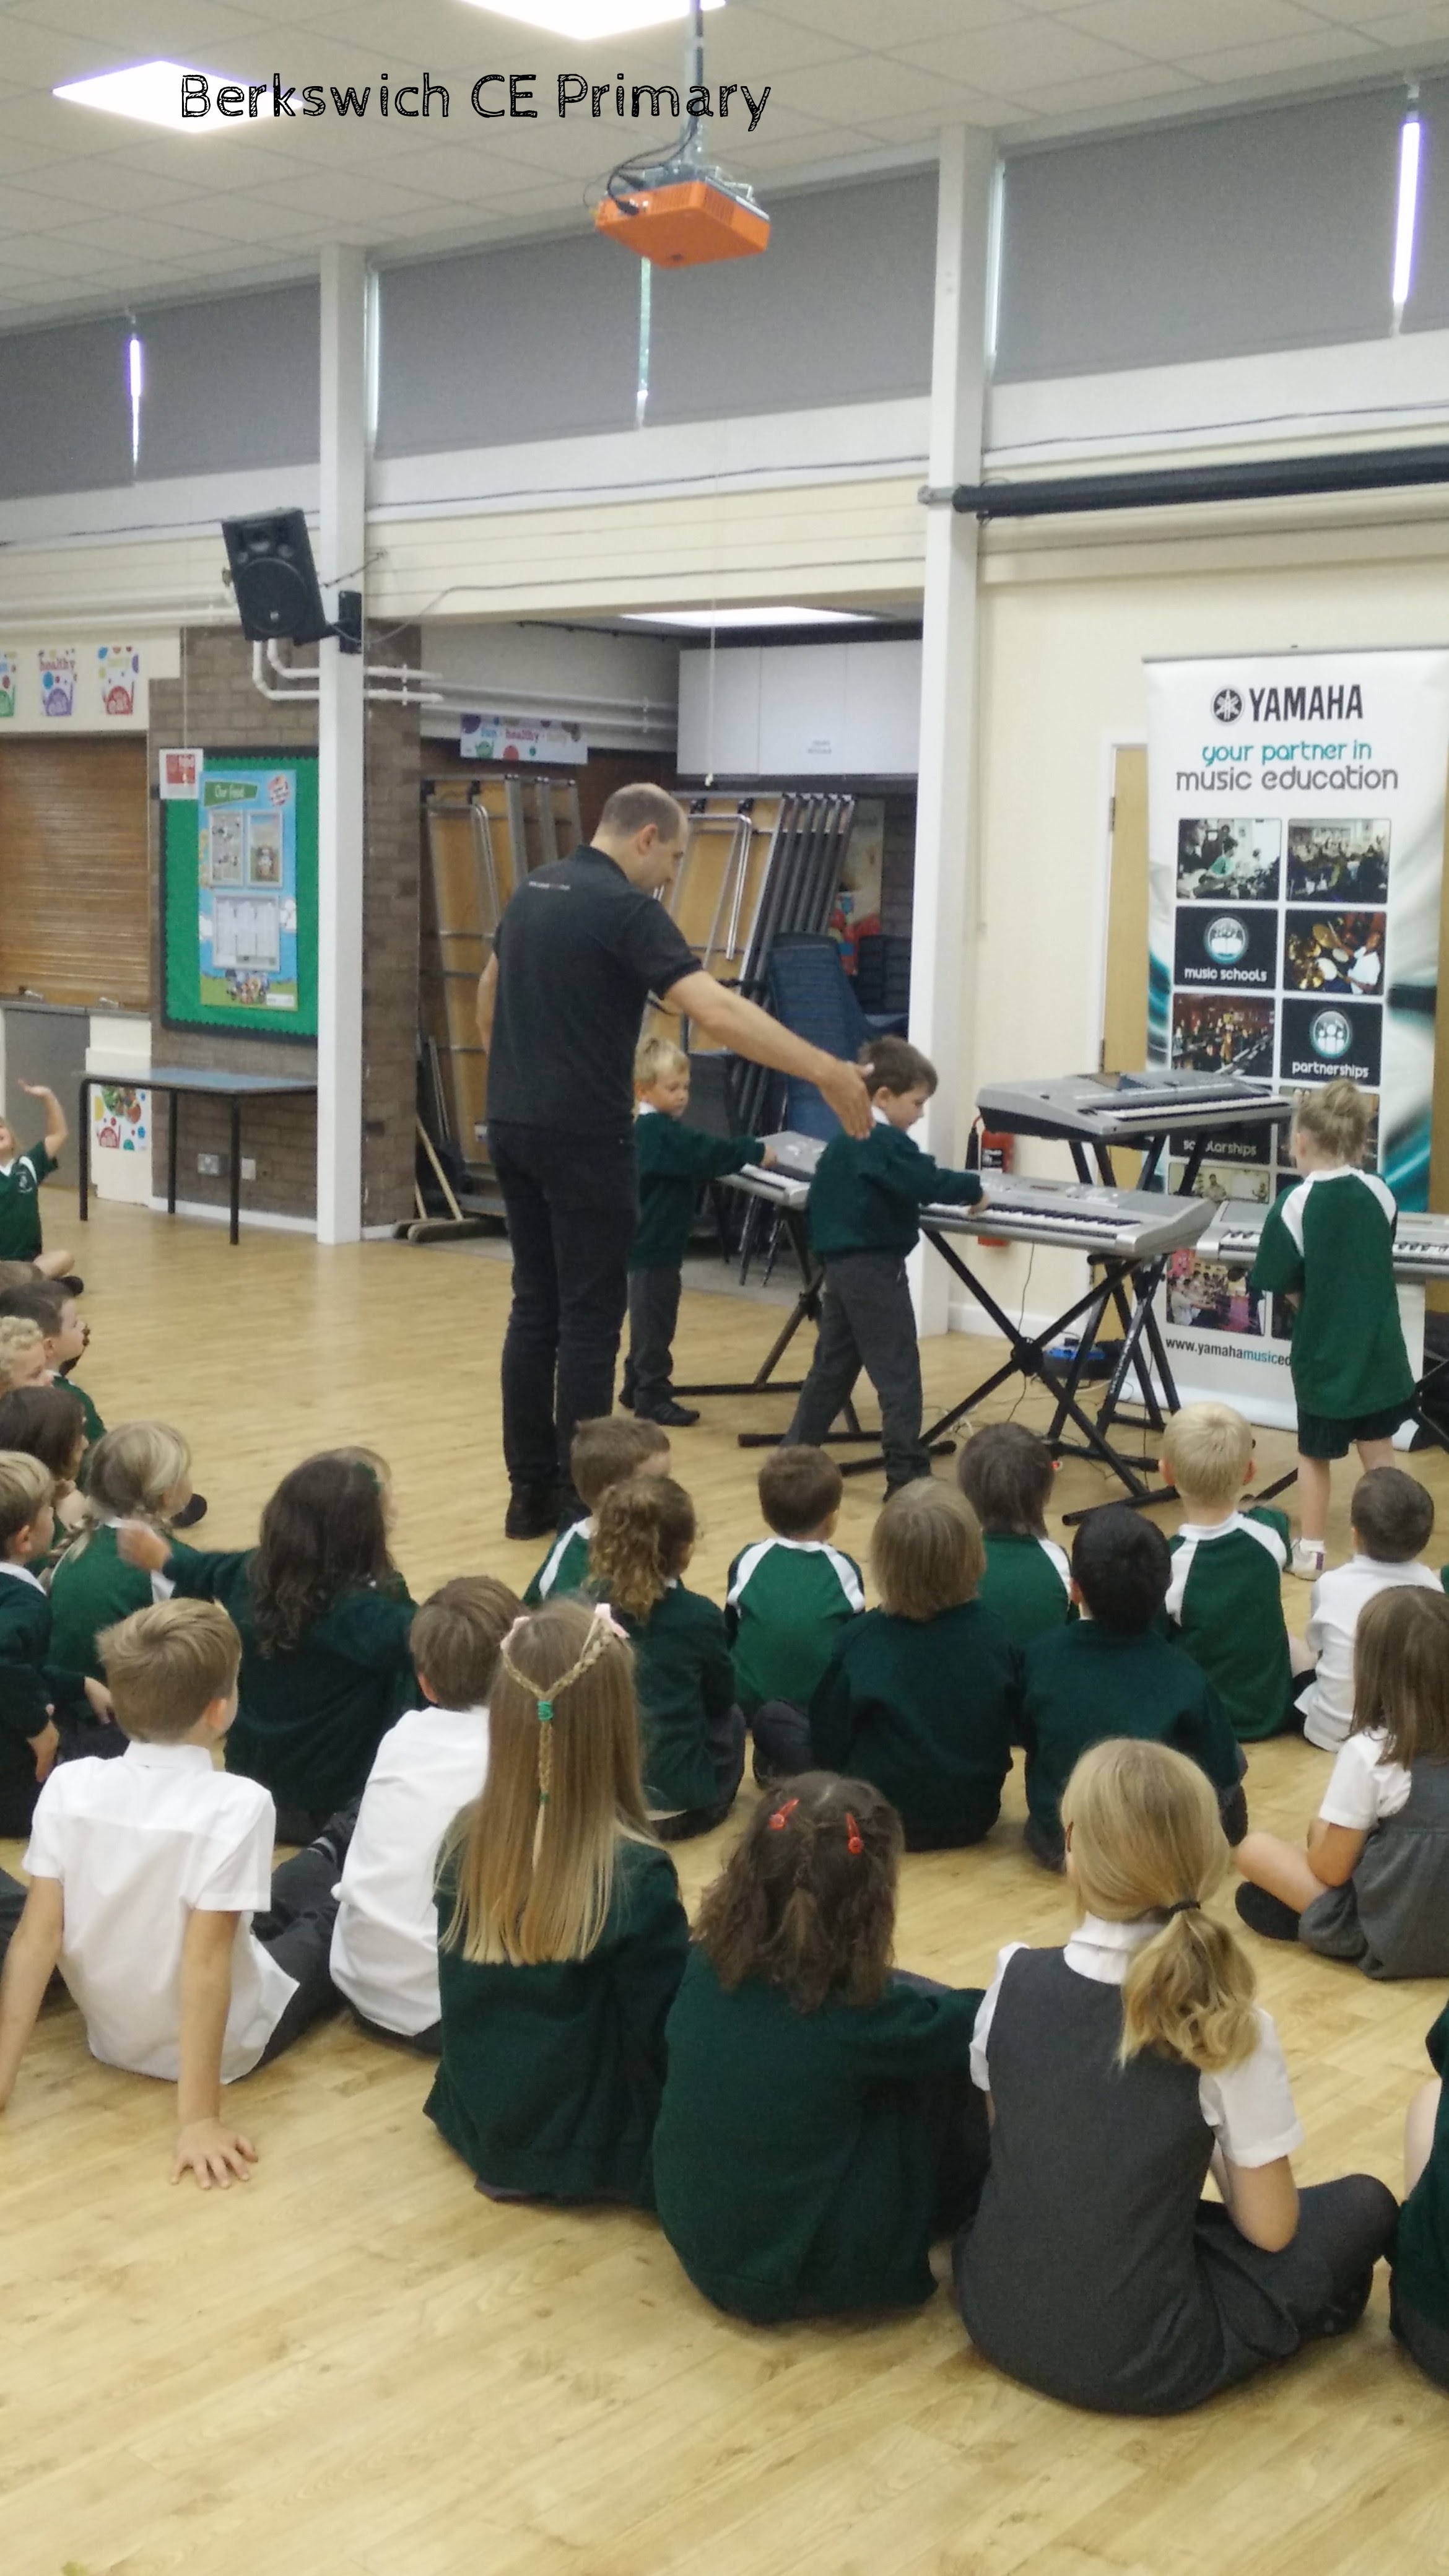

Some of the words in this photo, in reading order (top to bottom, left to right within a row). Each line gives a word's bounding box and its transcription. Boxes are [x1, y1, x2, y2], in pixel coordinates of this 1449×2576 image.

[40, 657, 76, 672] healthy
[1249, 684, 1364, 722] YAMAHA
[1202, 745, 1253, 767] your
[1261, 741, 1347, 765] partner
[1352, 740, 1372, 760] in
[1177, 767, 1252, 791] music
[1261, 765, 1399, 791] education
[1184, 967, 1218, 980] music
[1220, 967, 1267, 983] schools
[1292, 1061, 1369, 1079] partnerships
[1183, 1140, 1257, 1157] sclarships
